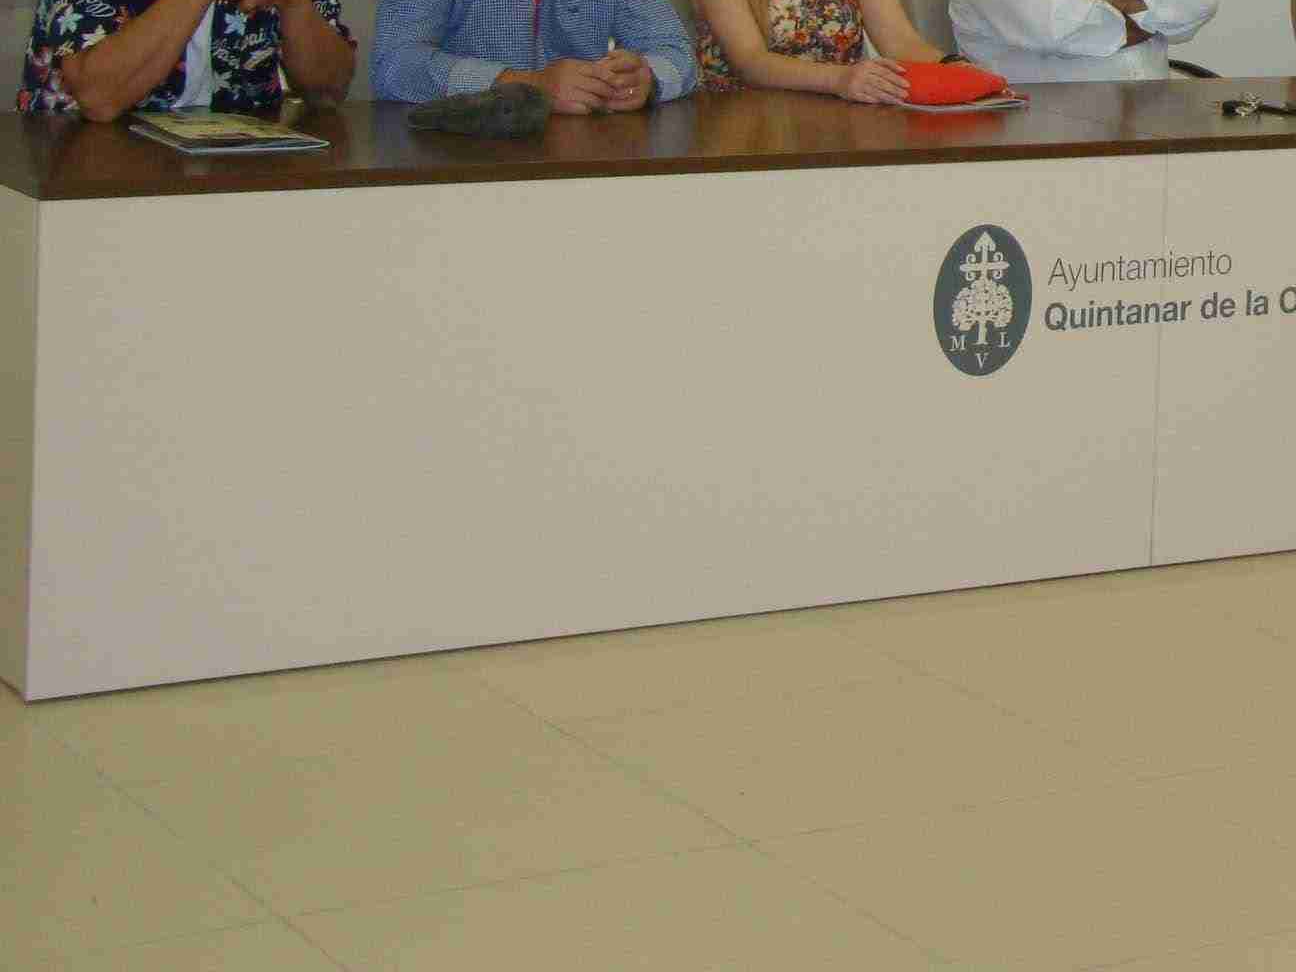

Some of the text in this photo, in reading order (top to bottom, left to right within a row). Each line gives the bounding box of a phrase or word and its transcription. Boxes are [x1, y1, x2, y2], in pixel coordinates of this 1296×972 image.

[1047, 249, 1232, 292] Ayuntamiento
[1044, 299, 1192, 331] Quintanar
[1200, 291, 1236, 320] de
[1245, 289, 1269, 316] la
[948, 331, 1010, 351] M L
[975, 352, 989, 369] V
